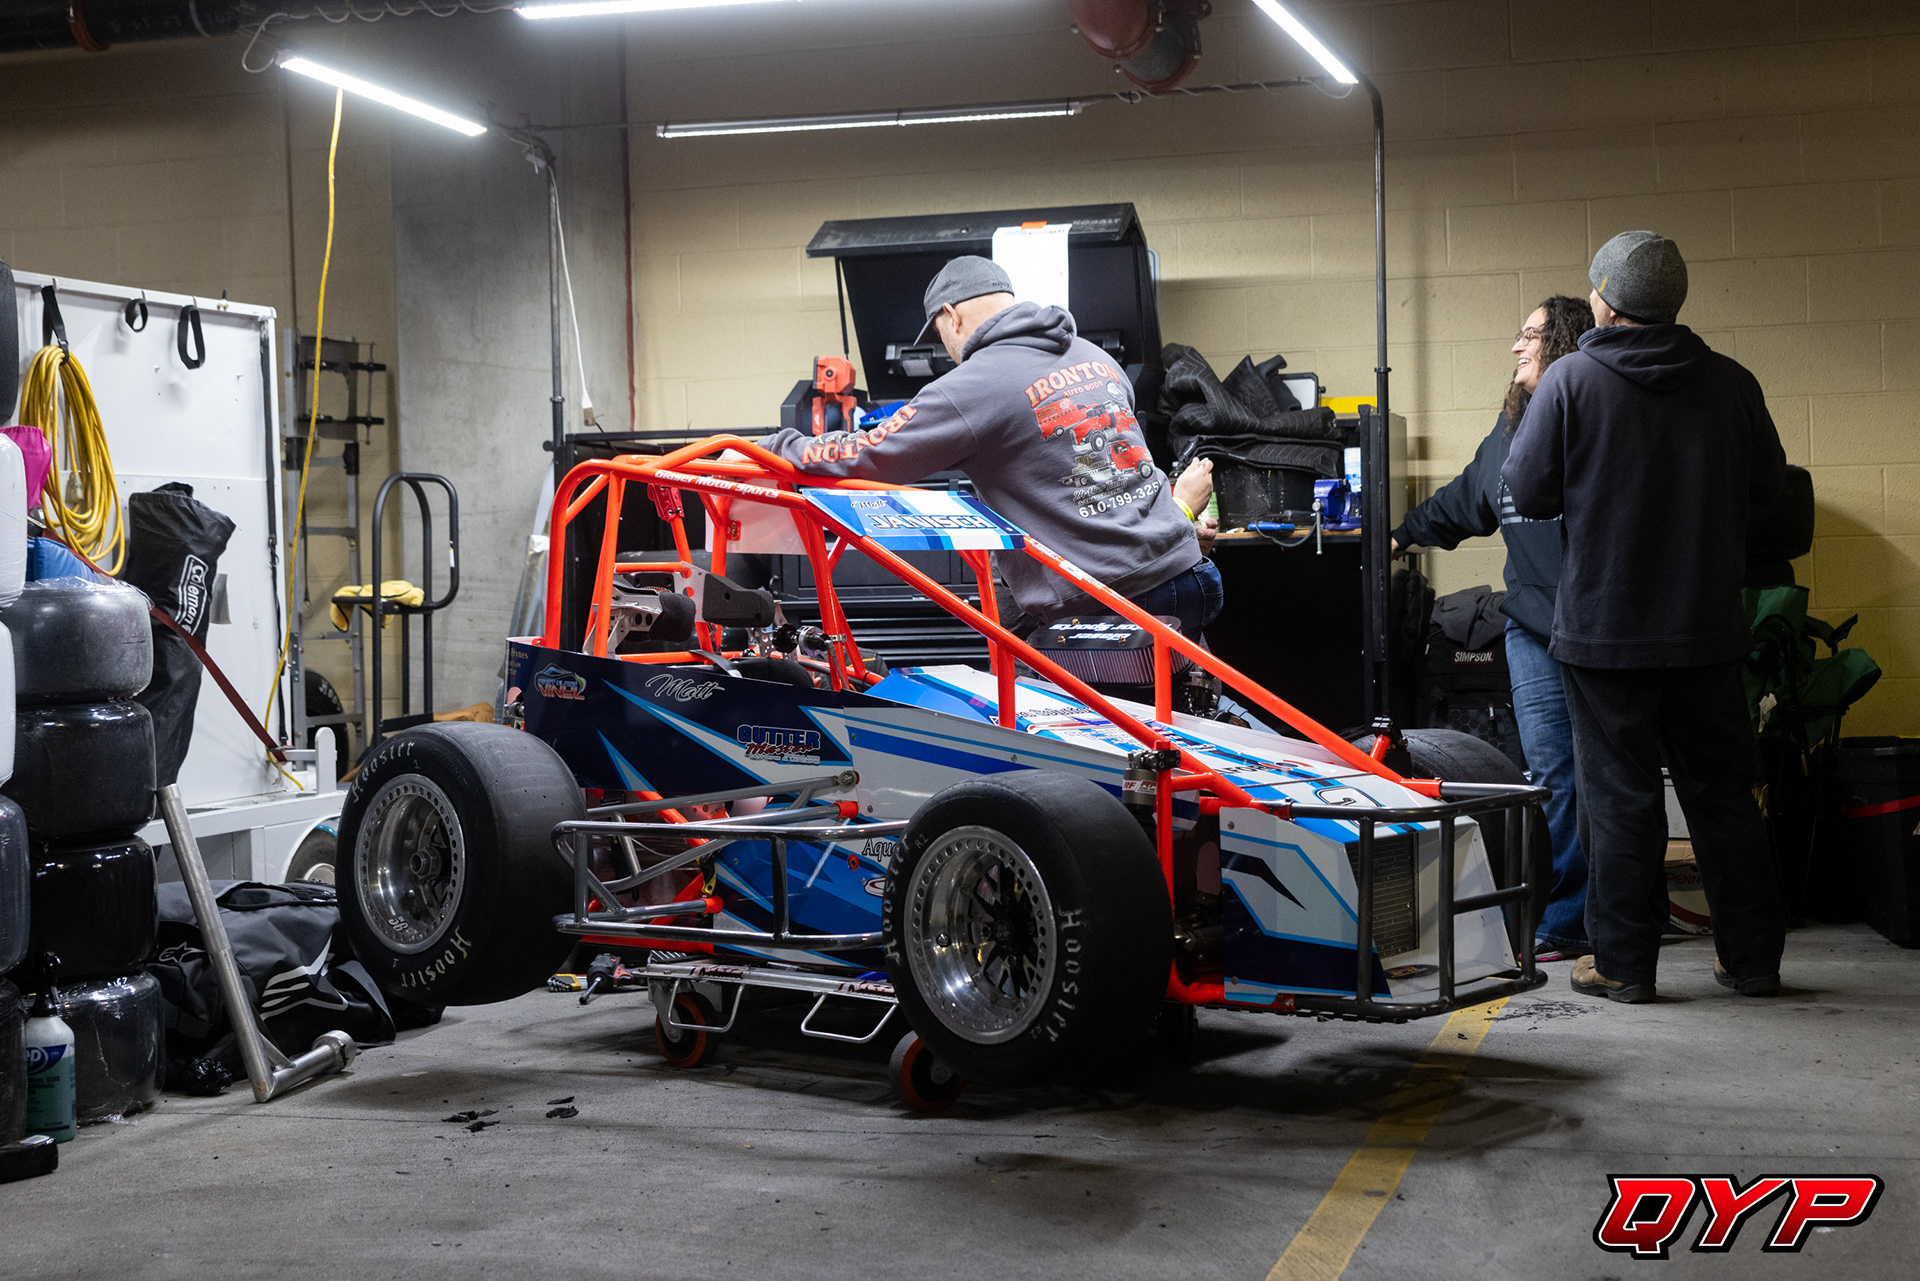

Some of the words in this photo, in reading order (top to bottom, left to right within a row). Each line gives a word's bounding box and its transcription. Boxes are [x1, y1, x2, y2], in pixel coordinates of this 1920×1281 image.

[1025, 361, 1120, 409] IRONTON
[1063, 387, 1084, 399] AUTO
[1084, 380, 1104, 392] BODY
[802, 404, 918, 465] IRONTON
[655, 469, 697, 484] Glaser
[851, 500, 888, 510] Matt
[1079, 480, 1162, 518] 610-799-325
[867, 514, 1000, 530] JANISCH
[185, 564, 205, 625] Coleman
[1454, 651, 1493, 662] SIMPSON
[645, 673, 725, 702] Matt
[737, 724, 821, 750] GUTTER
[745, 743, 815, 756] Master
[1124, 781, 1137, 789] RF
[862, 837, 898, 863] Aqu
